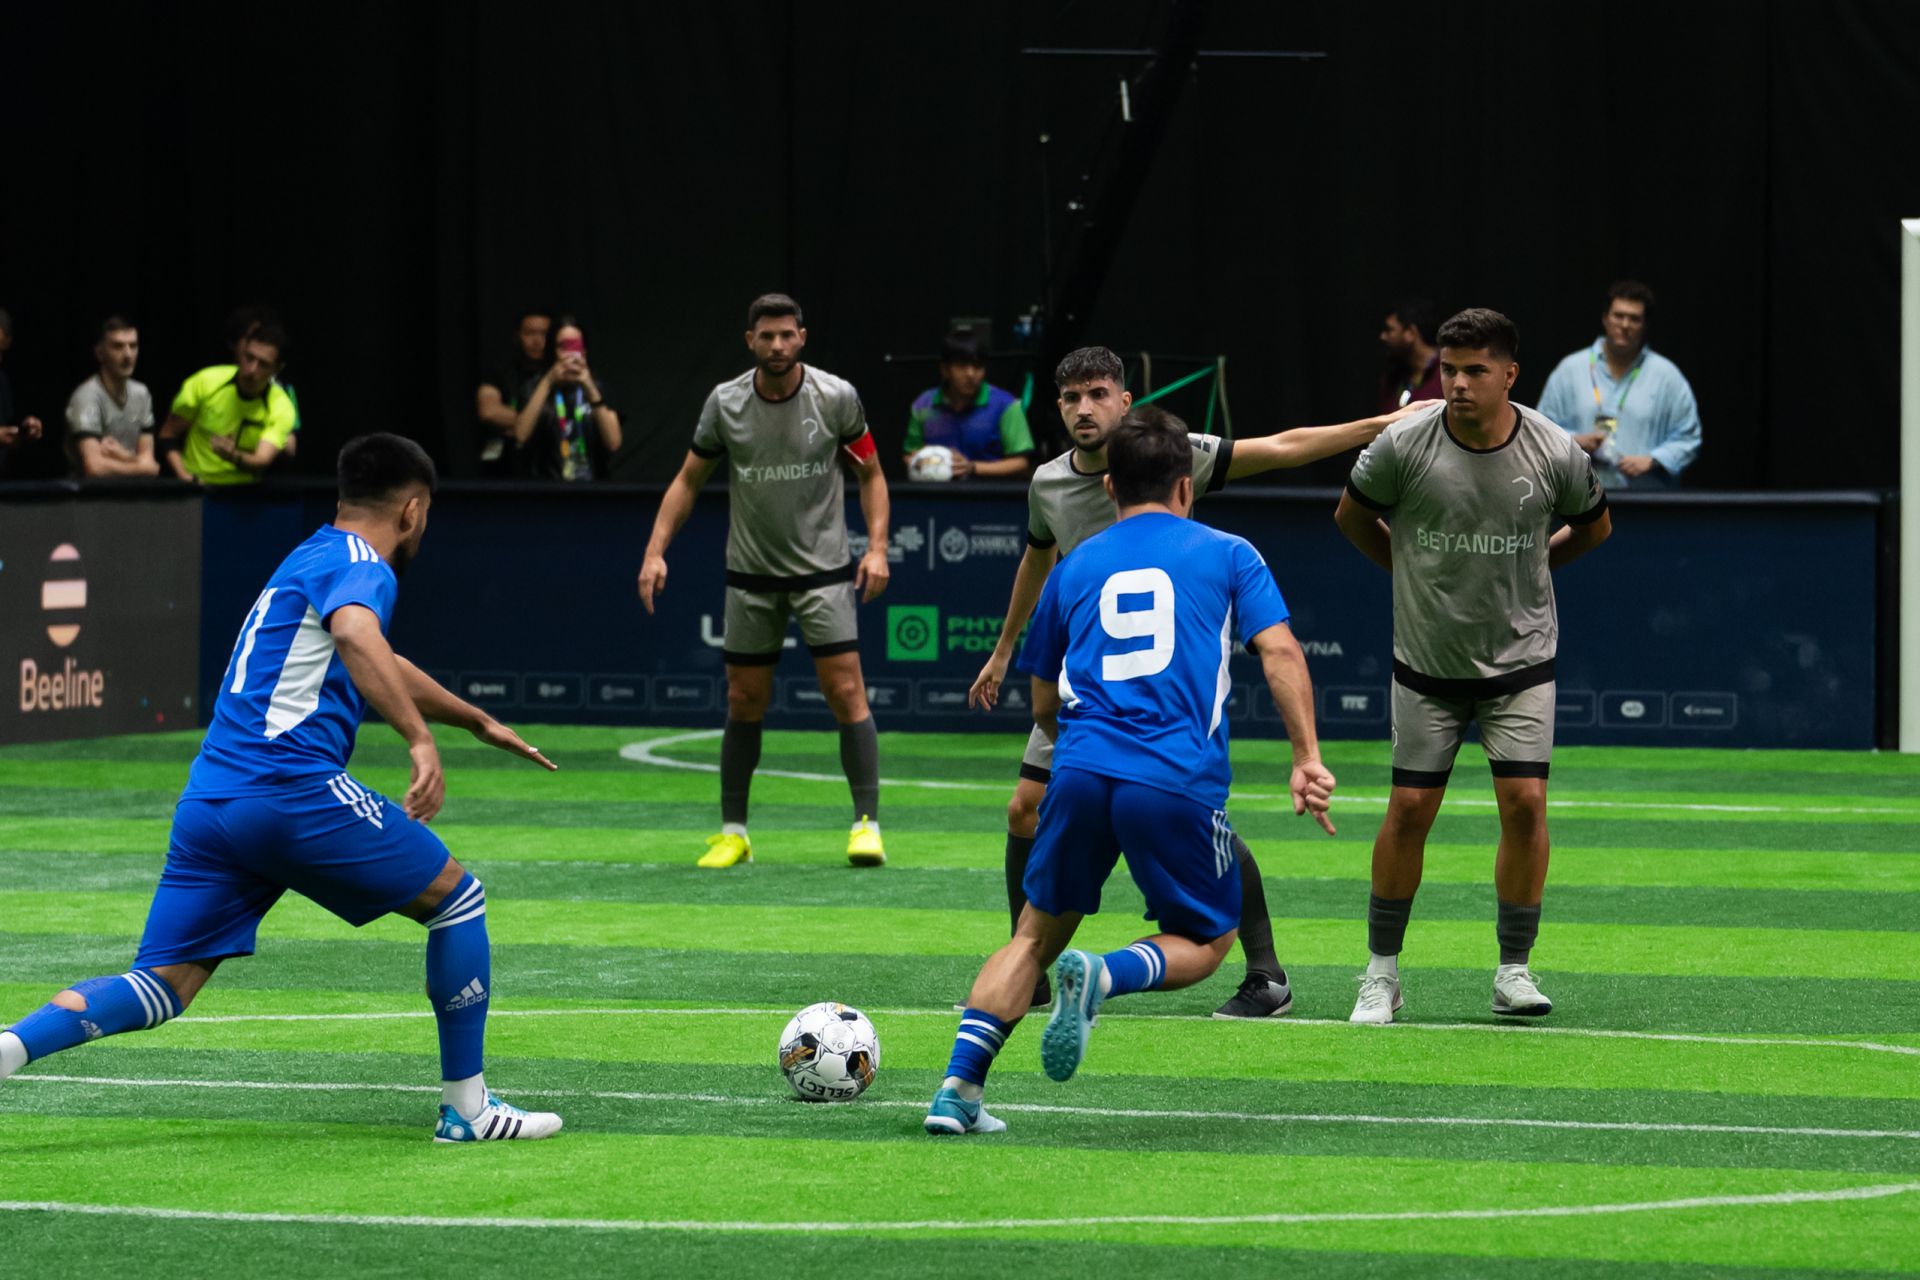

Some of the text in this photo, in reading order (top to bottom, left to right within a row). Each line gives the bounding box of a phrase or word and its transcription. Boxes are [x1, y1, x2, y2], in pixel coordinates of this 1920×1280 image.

[1416, 527, 1535, 555] BETANDEAL
[1099, 567, 1175, 681] 9
[1301, 641, 1344, 656] YNA
[19, 656, 105, 712] Beeline
[445, 991, 488, 1012] adidas
[799, 1077, 854, 1098] SELECT
